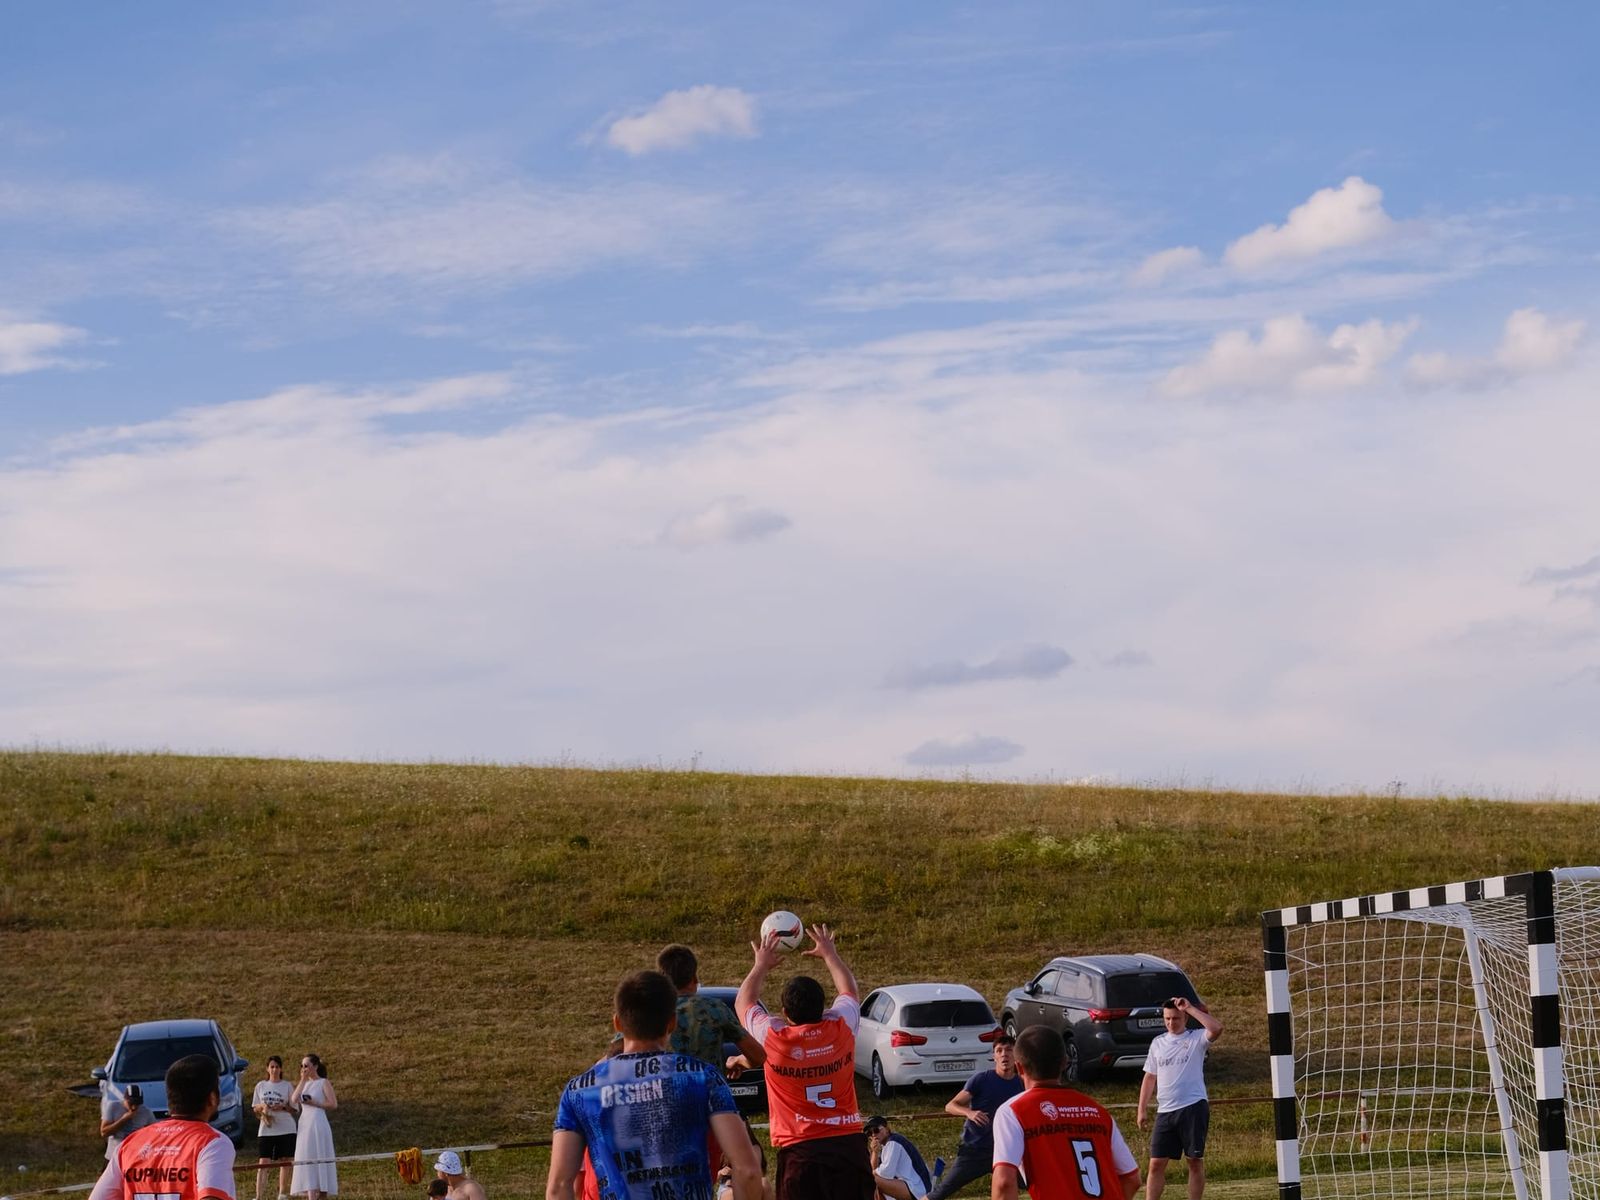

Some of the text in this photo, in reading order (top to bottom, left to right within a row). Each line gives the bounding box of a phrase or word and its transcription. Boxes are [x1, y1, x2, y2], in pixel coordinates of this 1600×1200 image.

[601, 1078, 664, 1108] DESIGN
[805, 1083, 836, 1109] 5
[1070, 1138, 1103, 1198] 5
